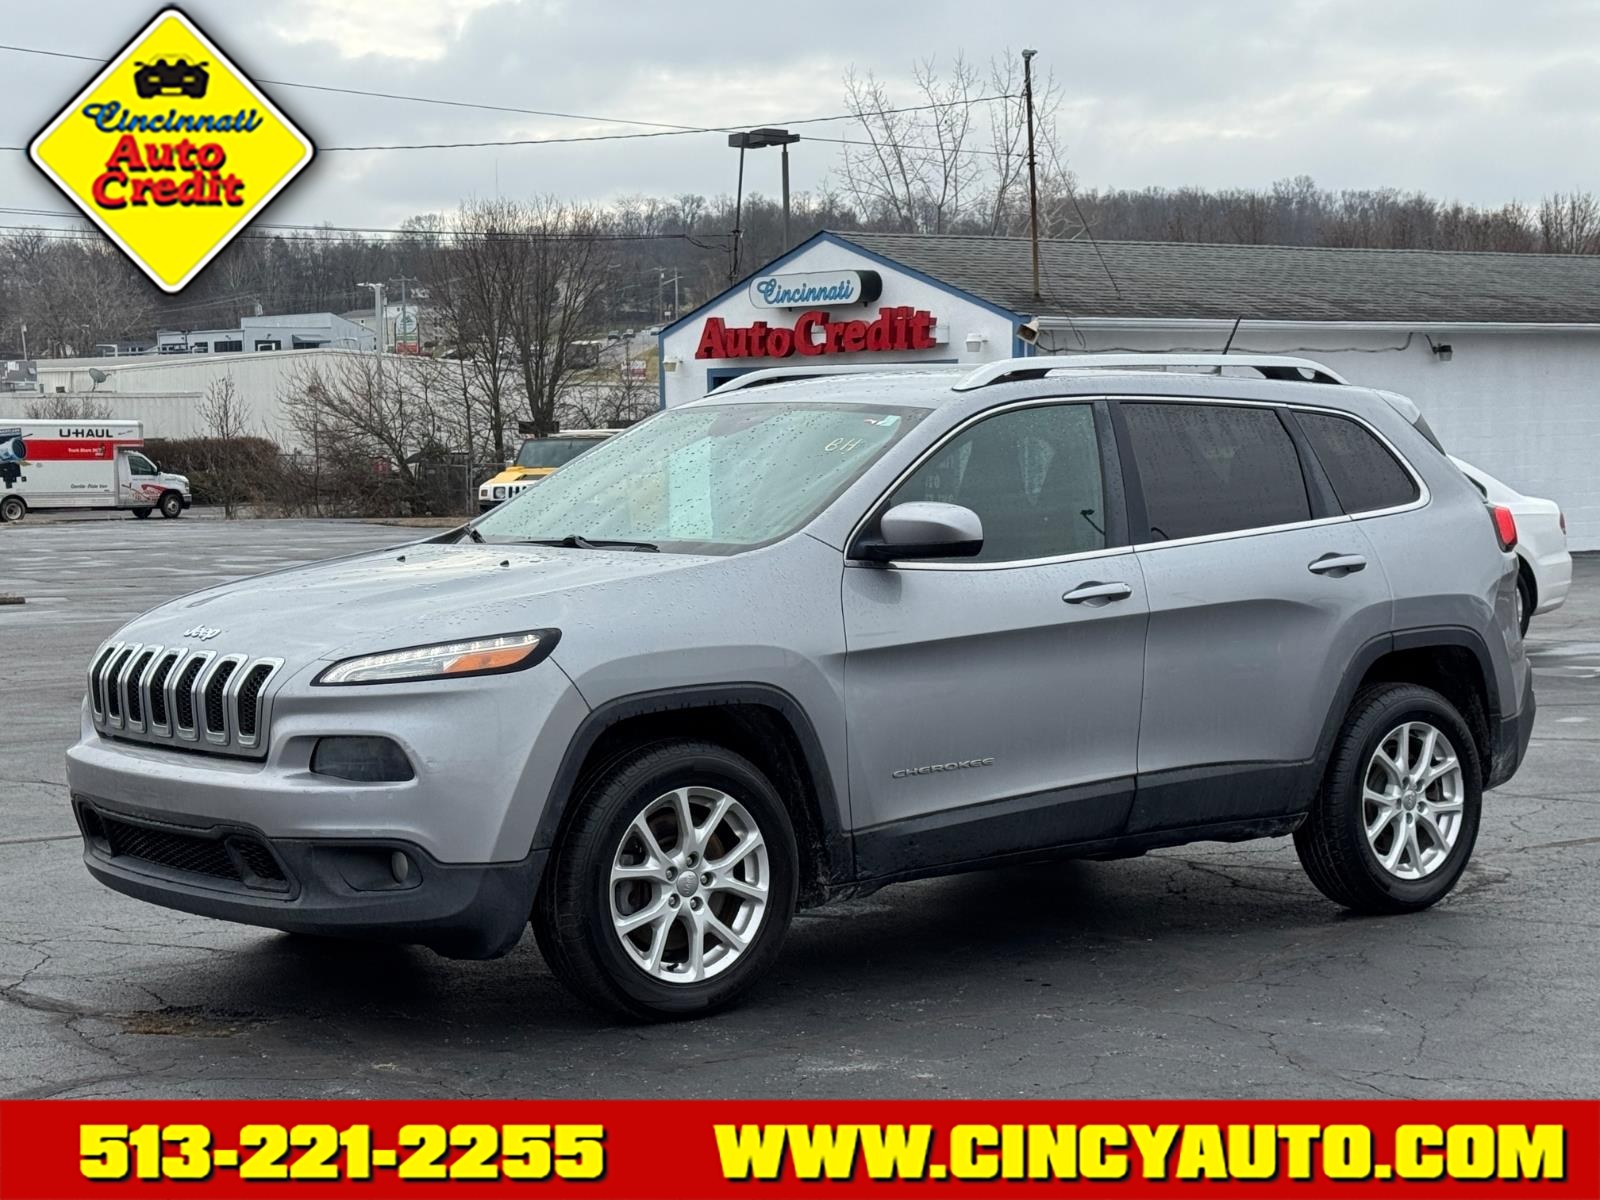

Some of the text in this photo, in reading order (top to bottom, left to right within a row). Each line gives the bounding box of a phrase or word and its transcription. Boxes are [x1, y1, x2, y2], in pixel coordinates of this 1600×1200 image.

[756, 277, 855, 306] Cincinnati
[59, 428, 113, 438] U-HAUL
[183, 624, 222, 642] Jeep
[892, 757, 995, 779] CHEROKEE
